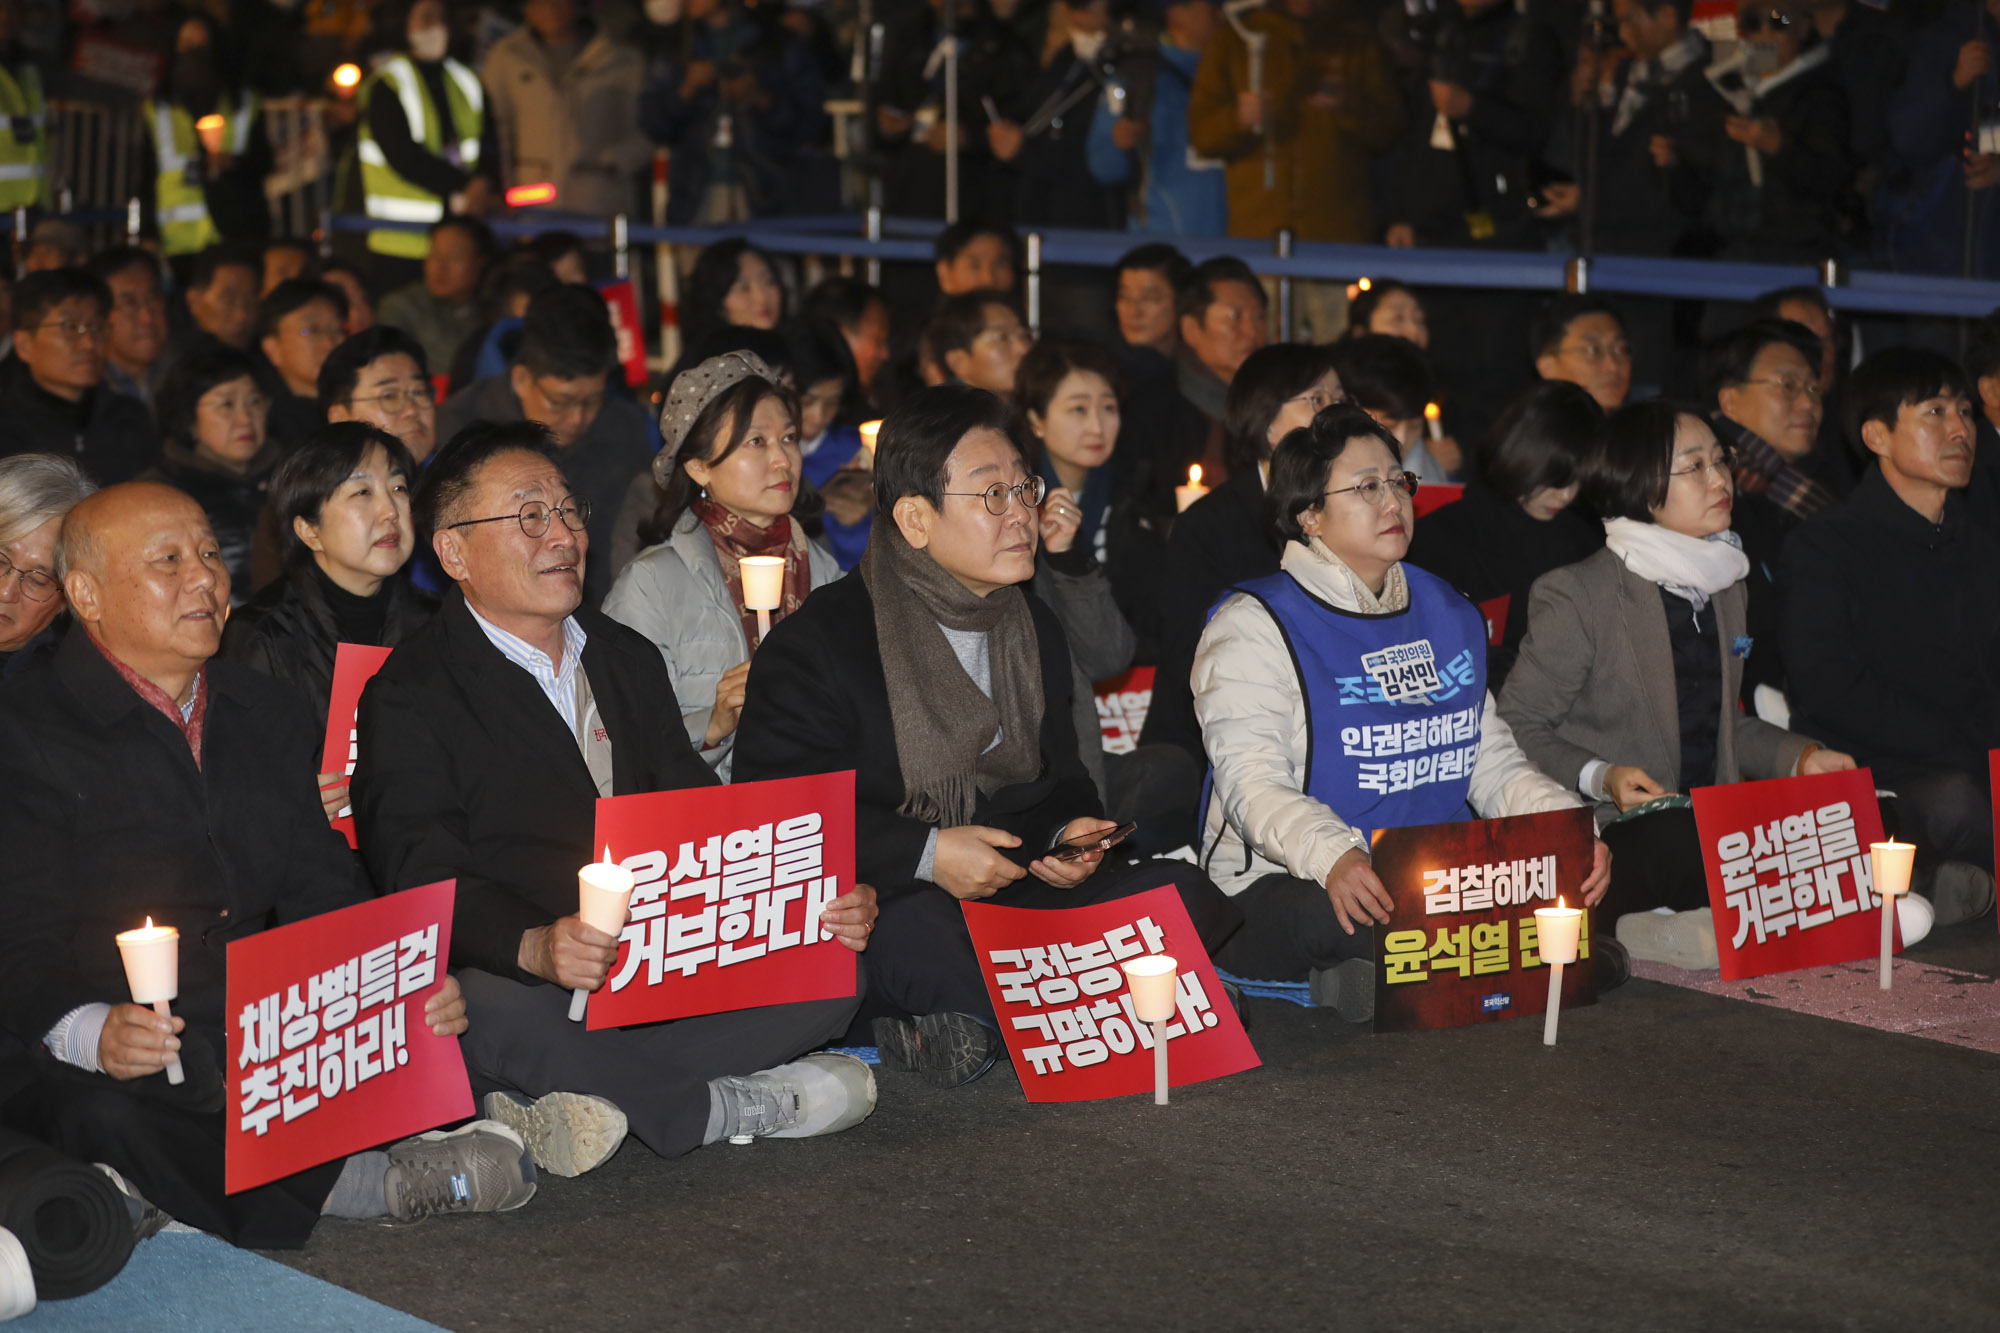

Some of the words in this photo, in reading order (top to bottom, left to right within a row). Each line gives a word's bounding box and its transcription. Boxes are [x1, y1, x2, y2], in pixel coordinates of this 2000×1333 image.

[1335, 649, 1475, 706] 조국신당
[1378, 661, 1437, 696] 김선민
[1387, 643, 1431, 665] 국회의원
[620, 813, 823, 921] 윤석열을
[1423, 855, 1556, 915] 검찰해체
[1717, 801, 1860, 893] 윤석열을
[611, 875, 837, 992] 거부한다!
[1384, 920, 1510, 984] 윤석열
[238, 923, 439, 1070] 채상병특검
[240, 1002, 408, 1136] 추진하라!
